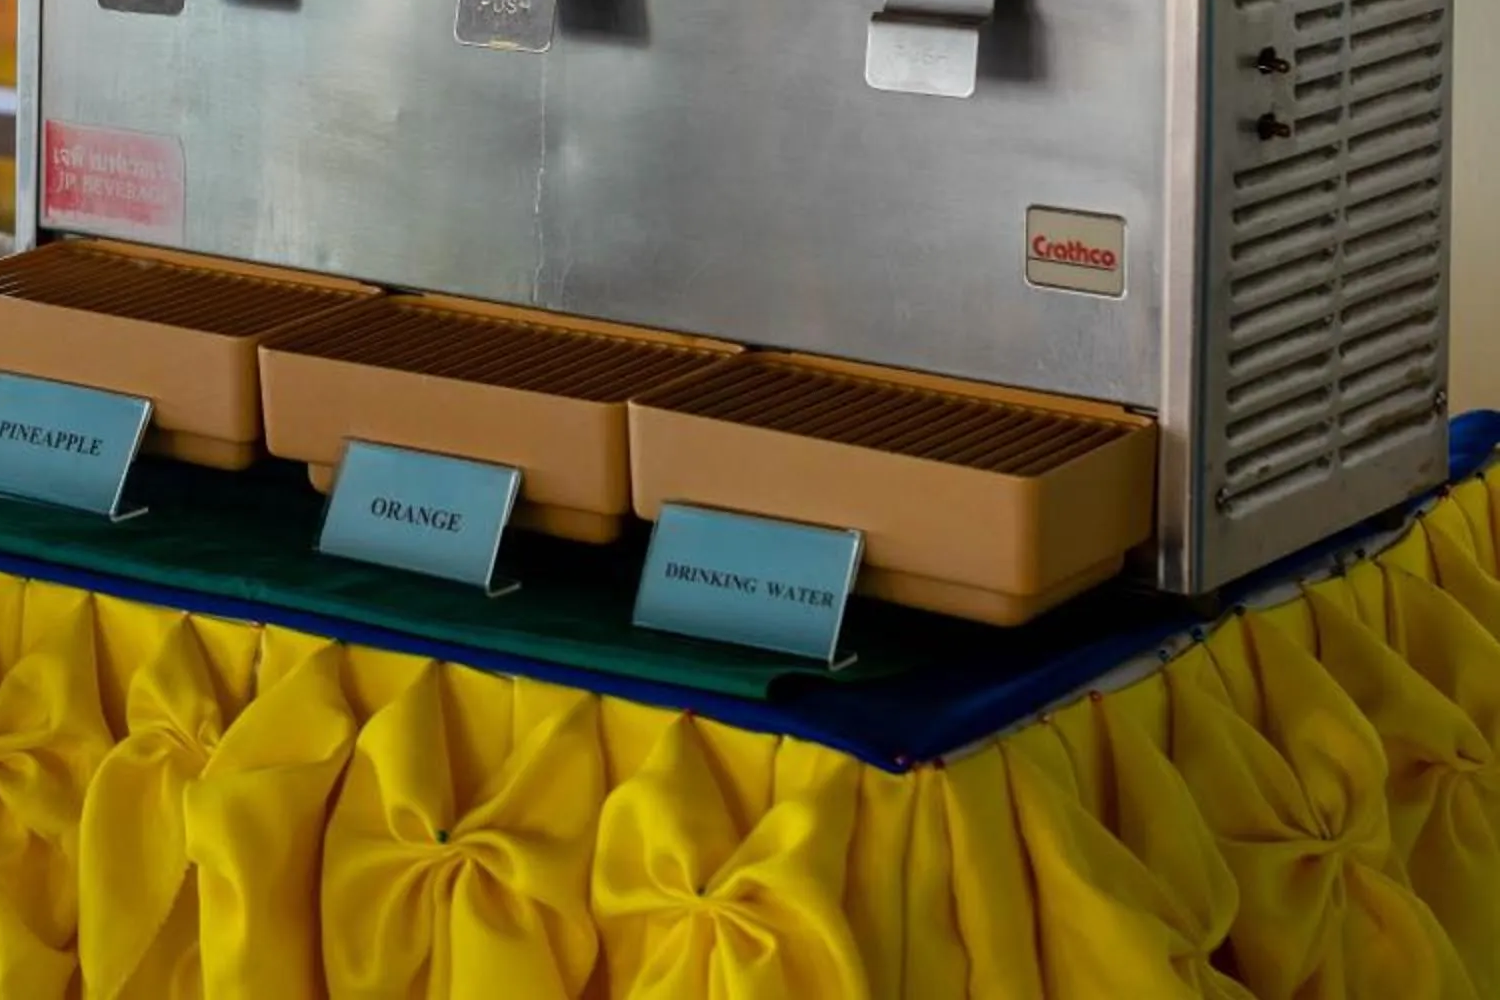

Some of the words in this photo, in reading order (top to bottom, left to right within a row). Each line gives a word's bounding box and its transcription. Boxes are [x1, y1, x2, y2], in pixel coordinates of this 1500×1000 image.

[1032, 235, 1116, 267] Crathco
[370, 497, 463, 533] ORANGE
[664, 561, 758, 594] DRINKING
[766, 581, 835, 608] WATER
